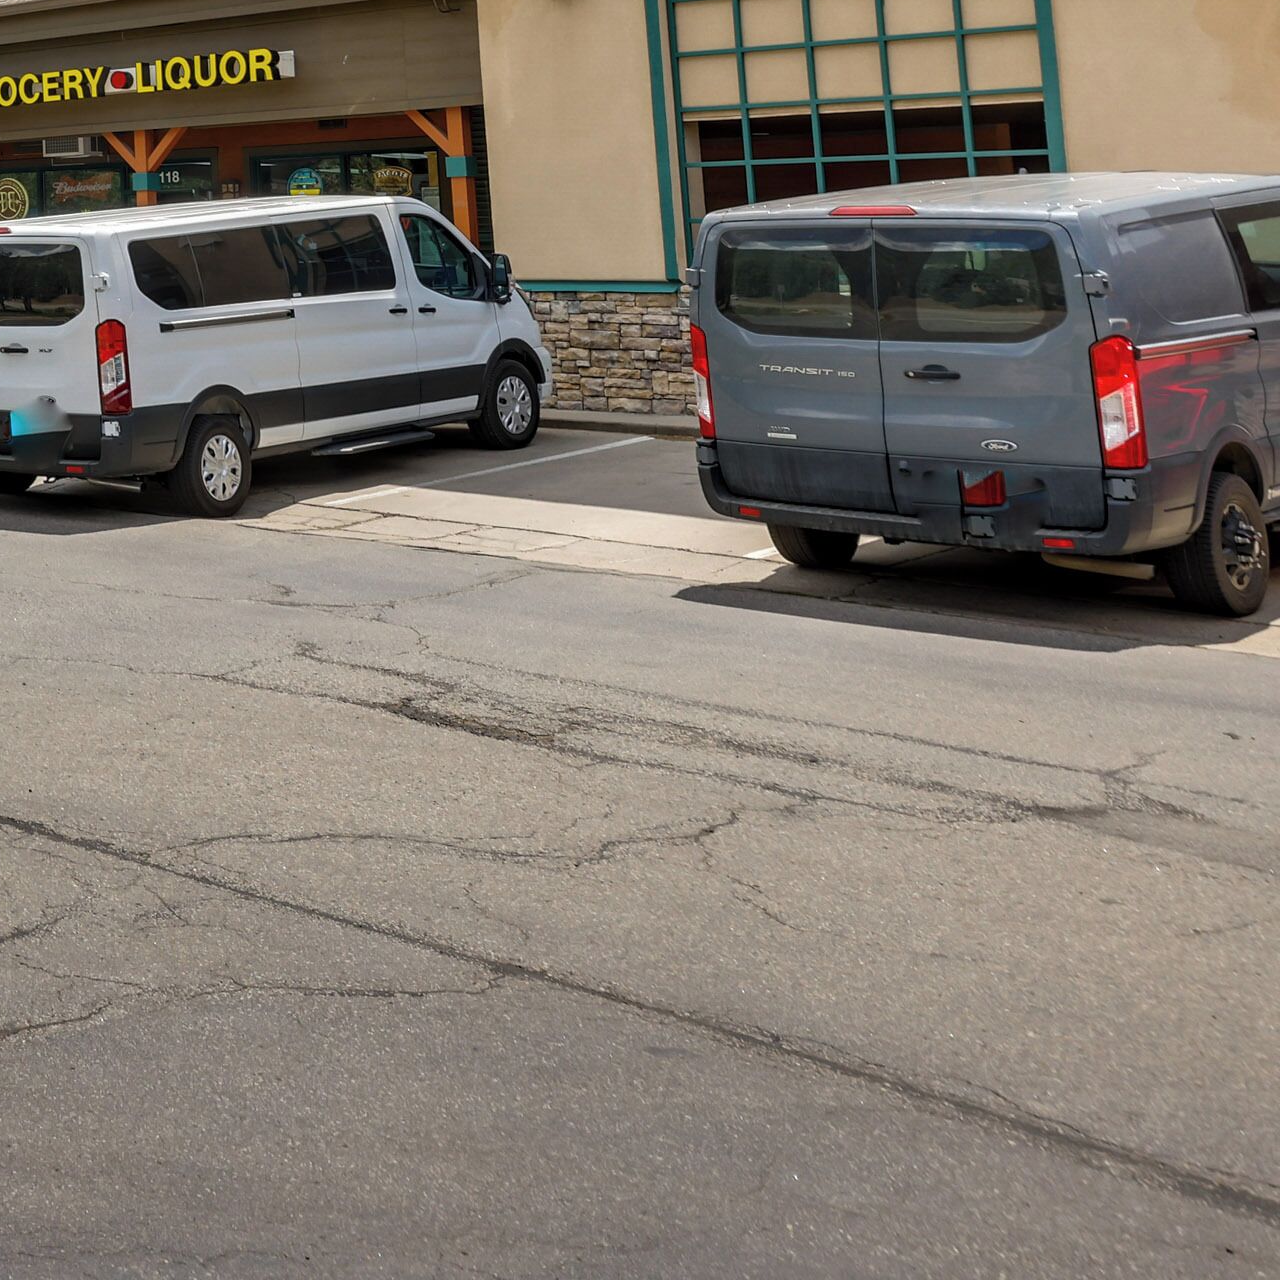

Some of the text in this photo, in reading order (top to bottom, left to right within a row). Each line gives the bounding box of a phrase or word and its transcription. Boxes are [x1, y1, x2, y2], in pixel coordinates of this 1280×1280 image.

[135, 48, 274, 93] LIQUOR
[159, 170, 180, 184] 118
[52, 181, 112, 195] Budweiser
[759, 364, 834, 376] TRANSIT
